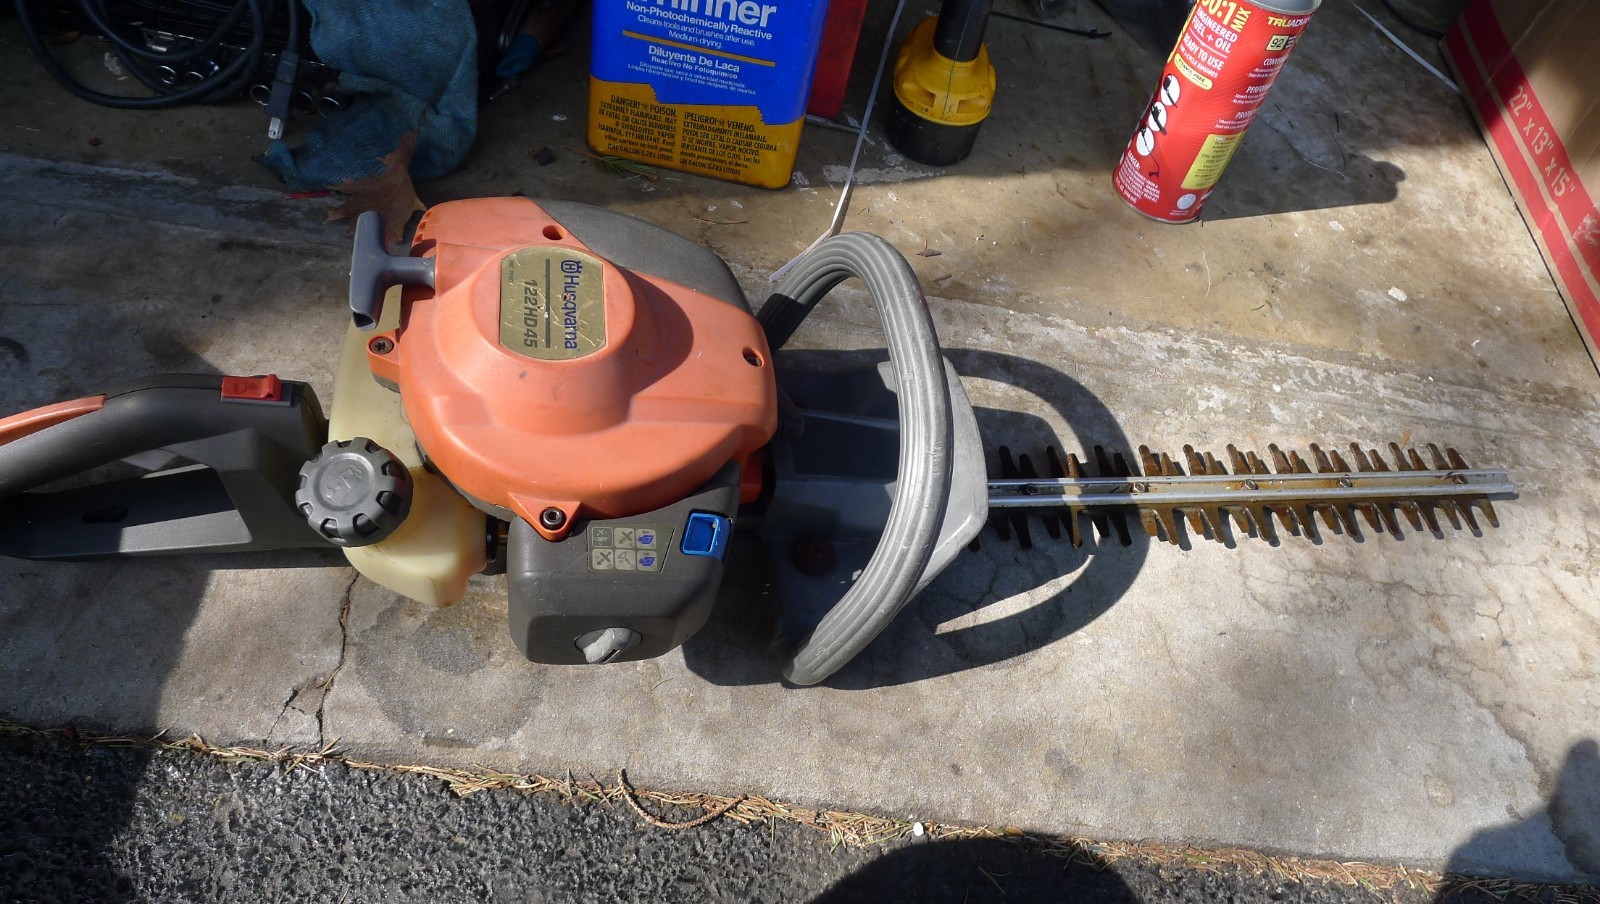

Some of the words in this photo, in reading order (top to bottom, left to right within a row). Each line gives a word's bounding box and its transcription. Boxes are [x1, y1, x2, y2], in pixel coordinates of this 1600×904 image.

[626, 1, 731, 33] Non-Photochemically
[730, 24, 772, 40] Reactive
[640, 0, 777, 27] nner
[1196, 6, 1238, 42] ENGINEERED
[1230, 6, 1252, 33] MIX
[638, 14, 663, 27] Cleans
[663, 19, 680, 31] tools
[681, 23, 696, 34] and
[695, 25, 724, 40] brushes
[725, 33, 741, 43] after
[741, 37, 756, 47] use.
[669, 30, 722, 49] Medium-drying.
[1192, 15, 1206, 37] FUEL
[1206, 33, 1214, 42] +
[1215, 37, 1231, 53] OIL
[1183, 32, 1200, 55] READY
[1197, 48, 1207, 62] TO
[1207, 56, 1225, 71] USE
[1270, 38, 1284, 48] 92
[648, 45, 696, 63] Diluyente
[699, 56, 713, 67] De
[715, 59, 740, 72] Laca
[651, 56, 681, 68] Reactivo
[683, 62, 693, 70] No
[600, 101, 629, 114] EXTREMELY
[664, 117, 677, 125] MAY
[611, 95, 640, 109] DANGER!
[650, 105, 677, 118] POISON.
[606, 110, 621, 120] FATAL
[631, 117, 647, 126] CAUSE
[649, 121, 676, 132] BLINDNESS
[683, 121, 732, 136] EXTREMADAMENTE
[727, 120, 756, 133] VENENO.
[657, 129, 675, 139] VAPOR
[682, 129, 698, 137] PUEDE
[711, 134, 725, 142] LETAL
[732, 138, 752, 148] CAUSAR
[753, 142, 777, 152] CEGUERA
[620, 145, 640, 155] GALLON
[657, 152, 673, 161] LITERS
[680, 143, 707, 153] IRRITANTE
[718, 143, 736, 152] VAPOR
[723, 166, 741, 175] LITROS
[523, 279, 538, 348] 122HD45
[561, 276, 579, 350] Husqvarna
